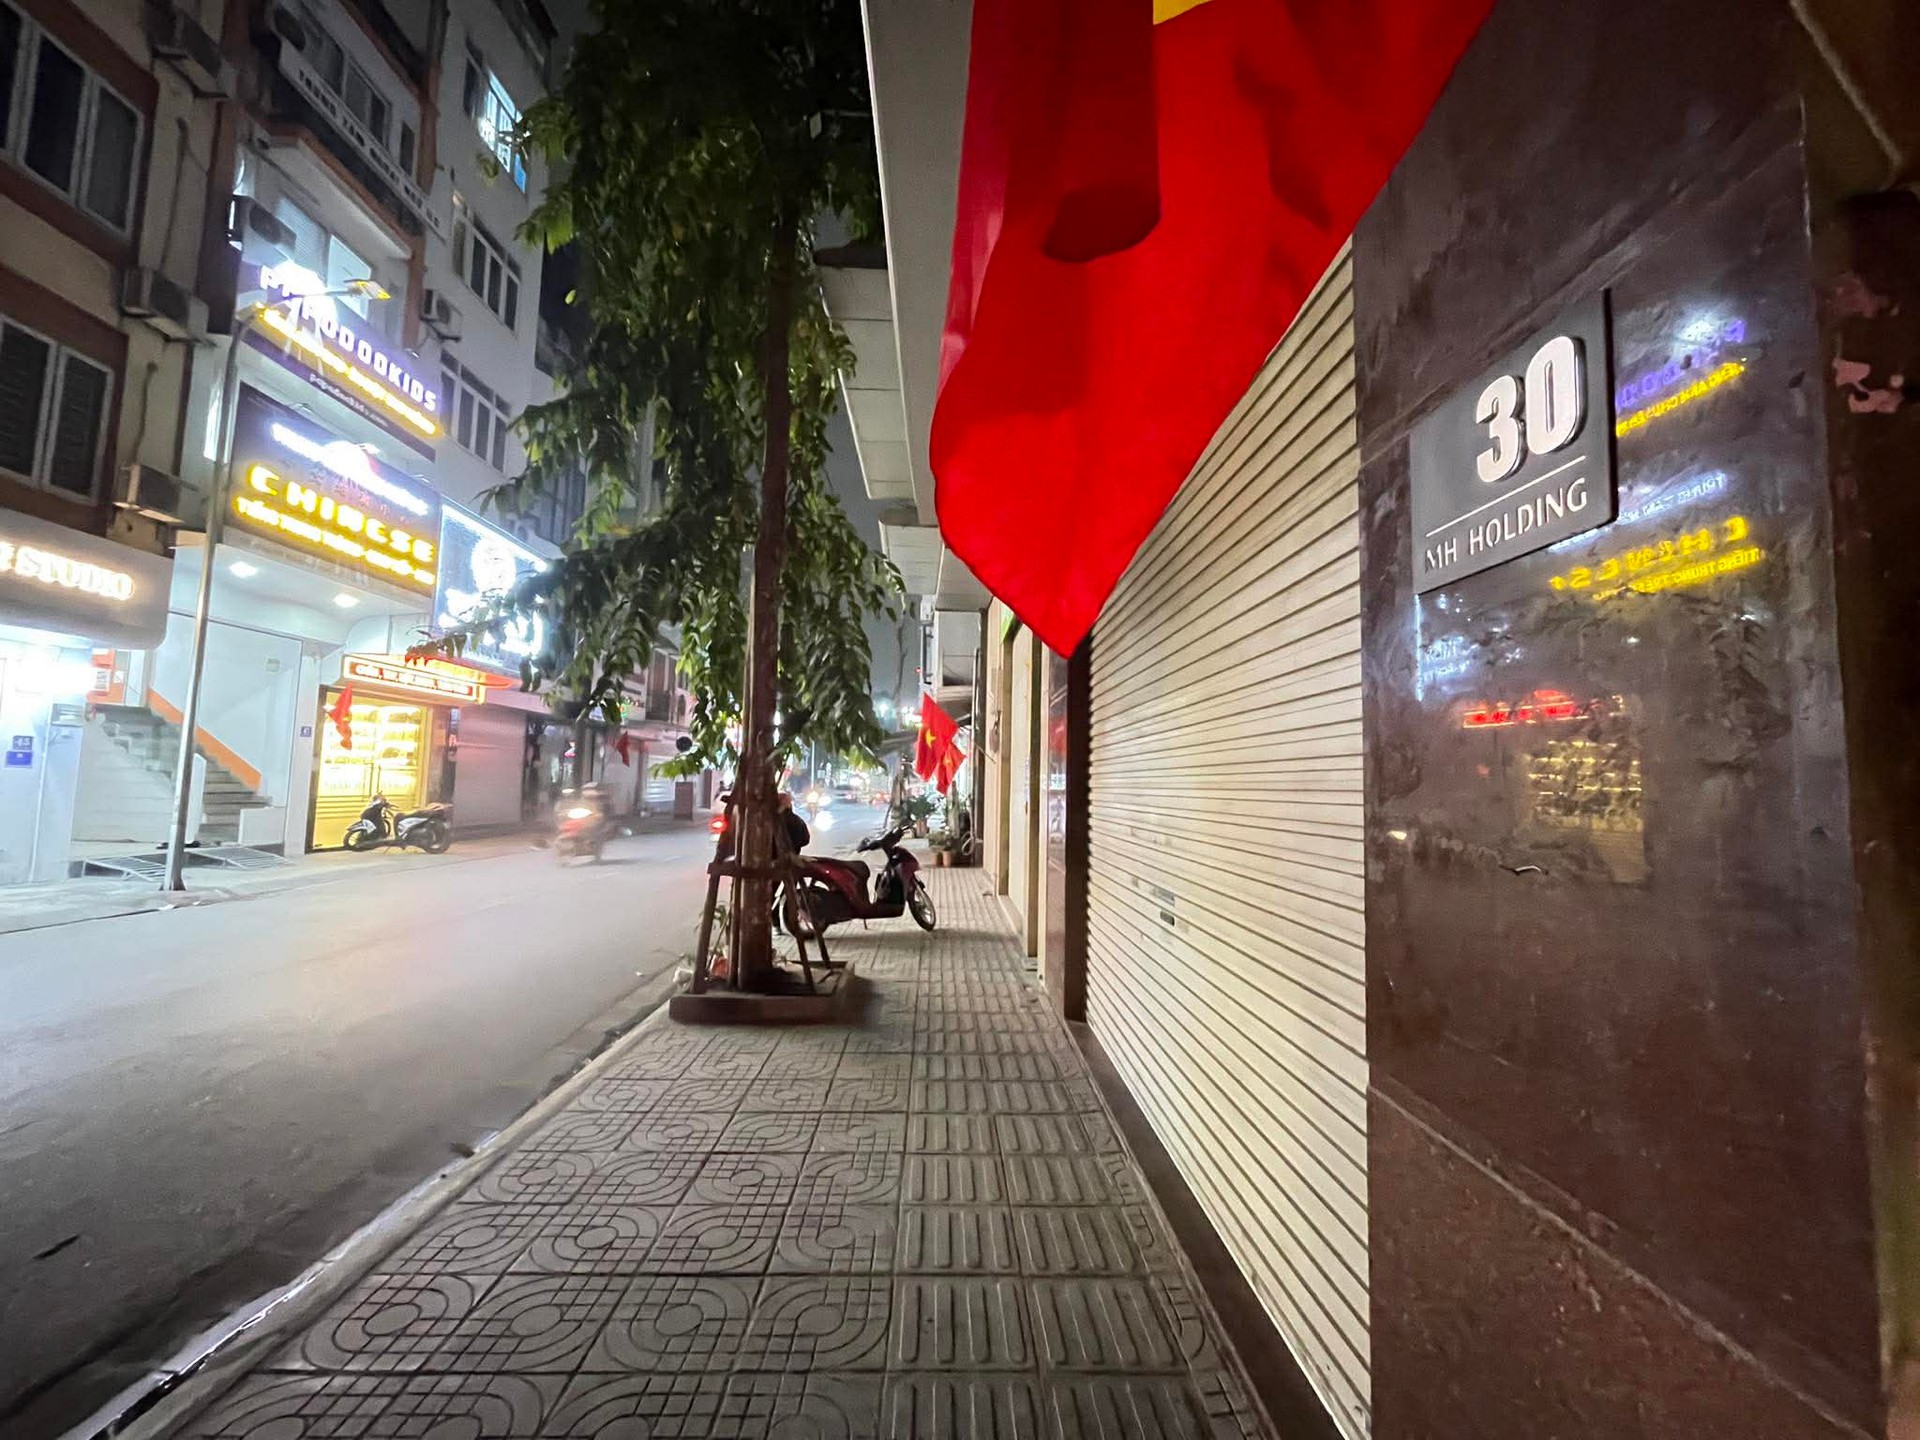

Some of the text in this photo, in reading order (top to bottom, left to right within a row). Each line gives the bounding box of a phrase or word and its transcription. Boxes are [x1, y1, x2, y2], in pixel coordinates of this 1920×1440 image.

[1475, 335, 1584, 483] 30
[249, 464, 435, 563] CHINESE
[1425, 538, 1458, 573] MH
[1469, 477, 1587, 556] HOLDING
